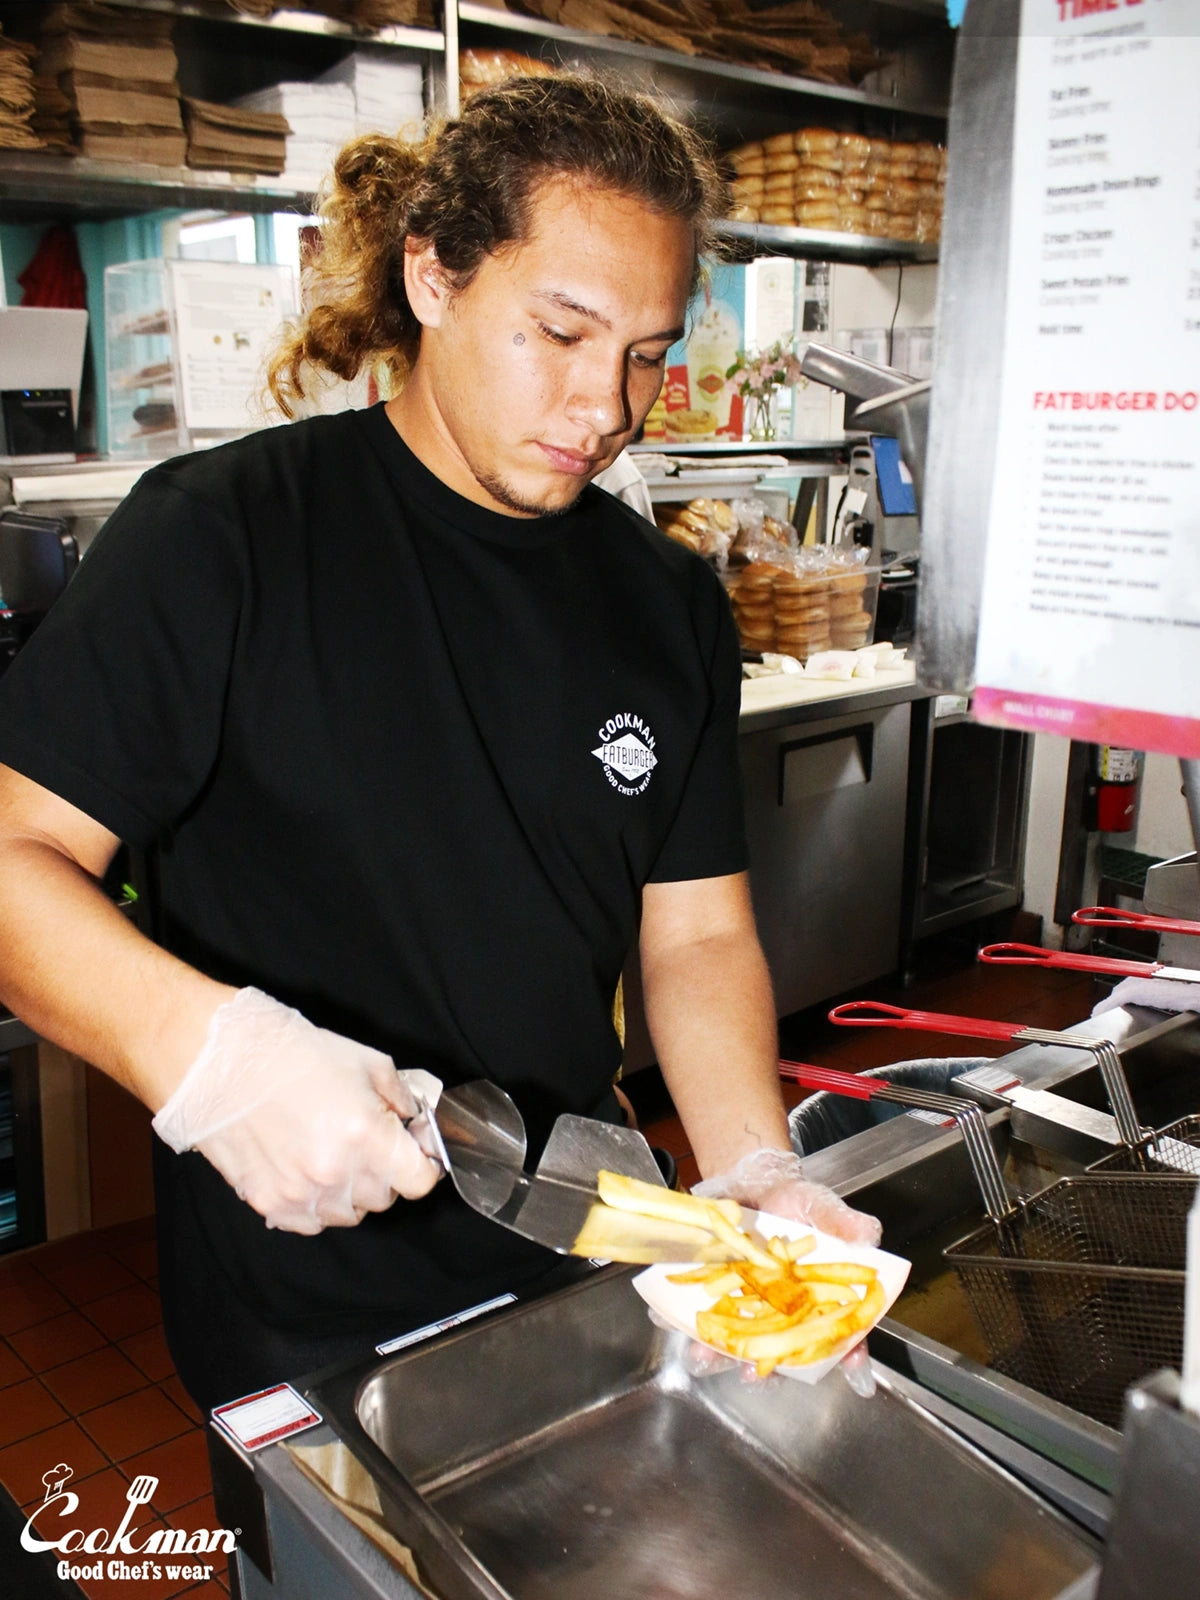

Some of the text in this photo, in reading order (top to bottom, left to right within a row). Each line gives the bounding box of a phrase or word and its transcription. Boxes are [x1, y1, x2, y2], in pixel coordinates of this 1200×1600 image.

[1034, 391, 1157, 411] FATBURGER
[598, 712, 656, 751] COOKMAN
[603, 745, 653, 770] FATBURGER
[603, 765, 618, 787] GOOD
[617, 784, 640, 796] CHEF'S
